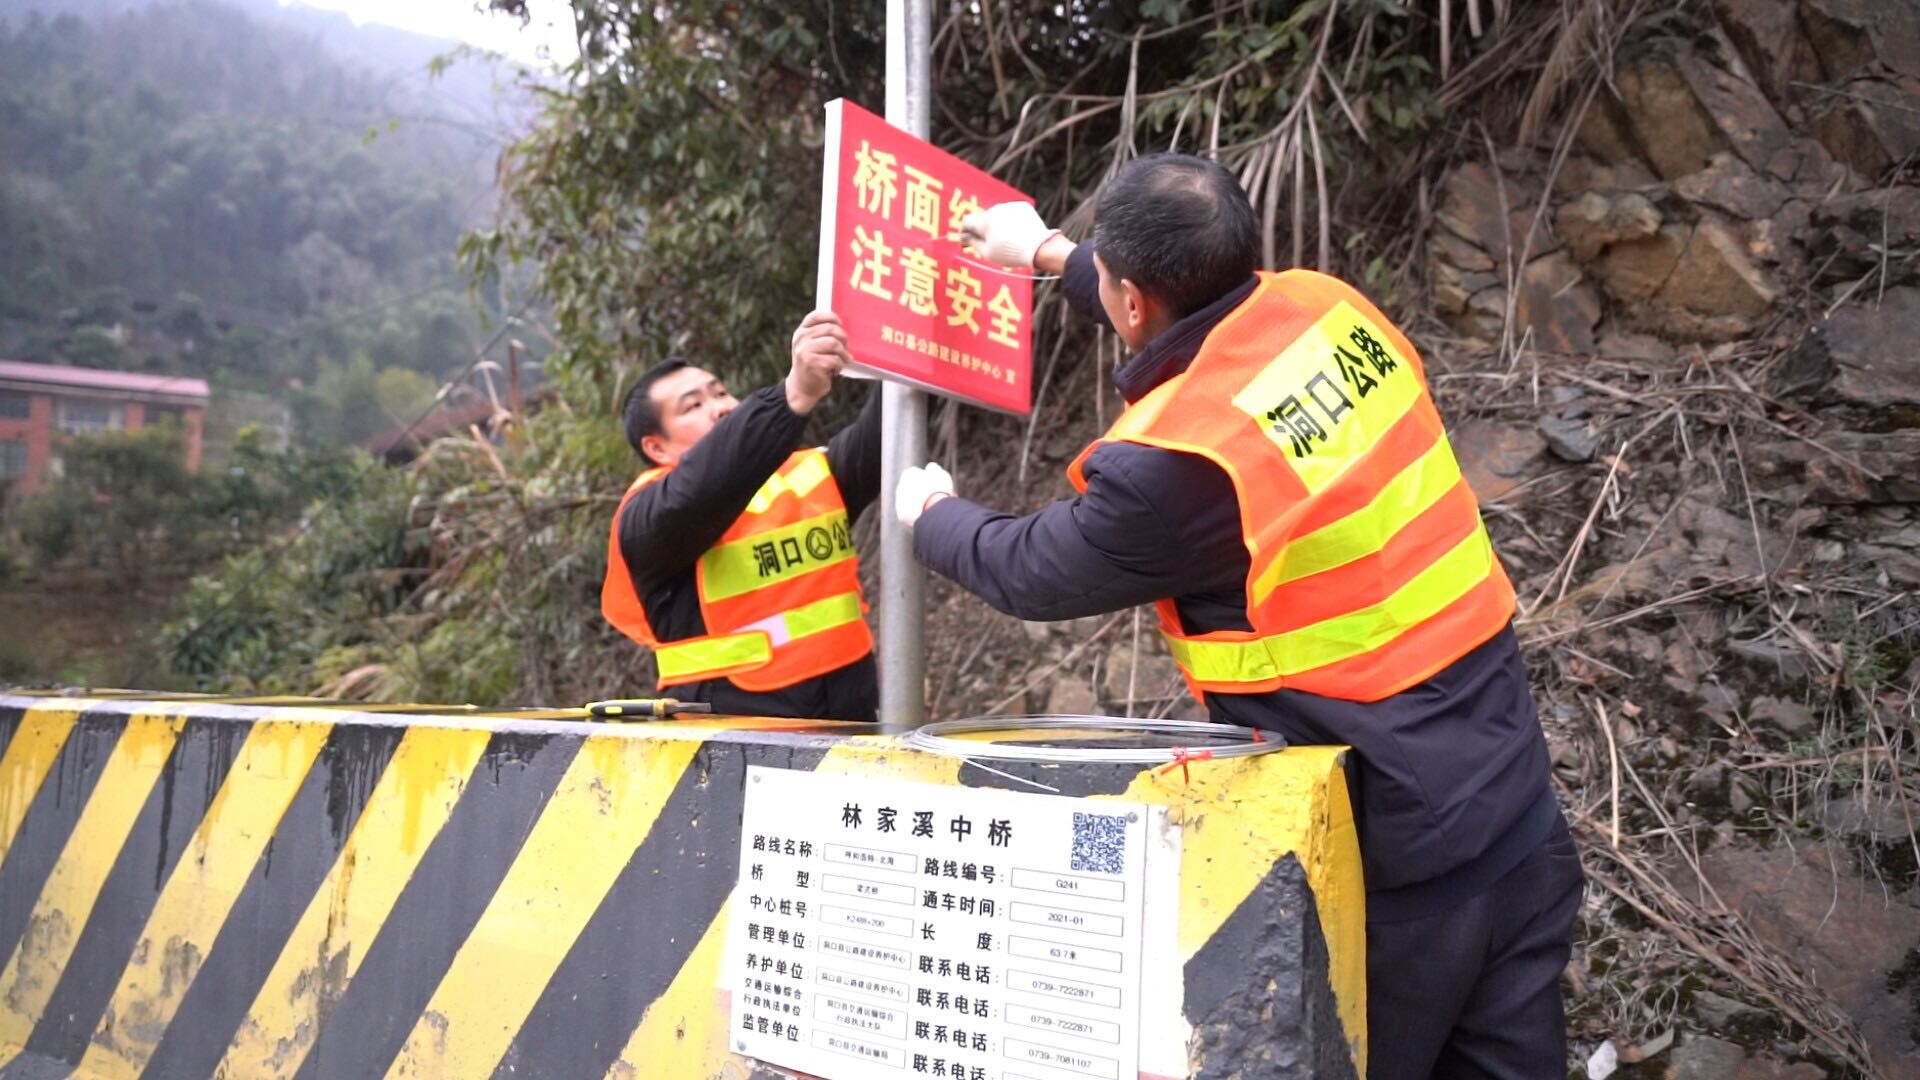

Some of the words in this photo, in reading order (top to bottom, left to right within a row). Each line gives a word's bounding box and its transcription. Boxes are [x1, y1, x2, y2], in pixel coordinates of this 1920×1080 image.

[853, 139, 1000, 262] 桥面
[850, 224, 1022, 349] 注意安全
[1267, 325, 1398, 458] 洞口公路
[752, 537, 804, 577] 洞口
[842, 803, 1012, 847] 林家溪中桥
[1056, 879, 1079, 890] G241
[1048, 912, 1084, 926] 2021-01
[1050, 948, 1077, 960] 637米
[1032, 980, 1094, 998] 0739-7222871
[1030, 1015, 1093, 1033] 0739-7222871
